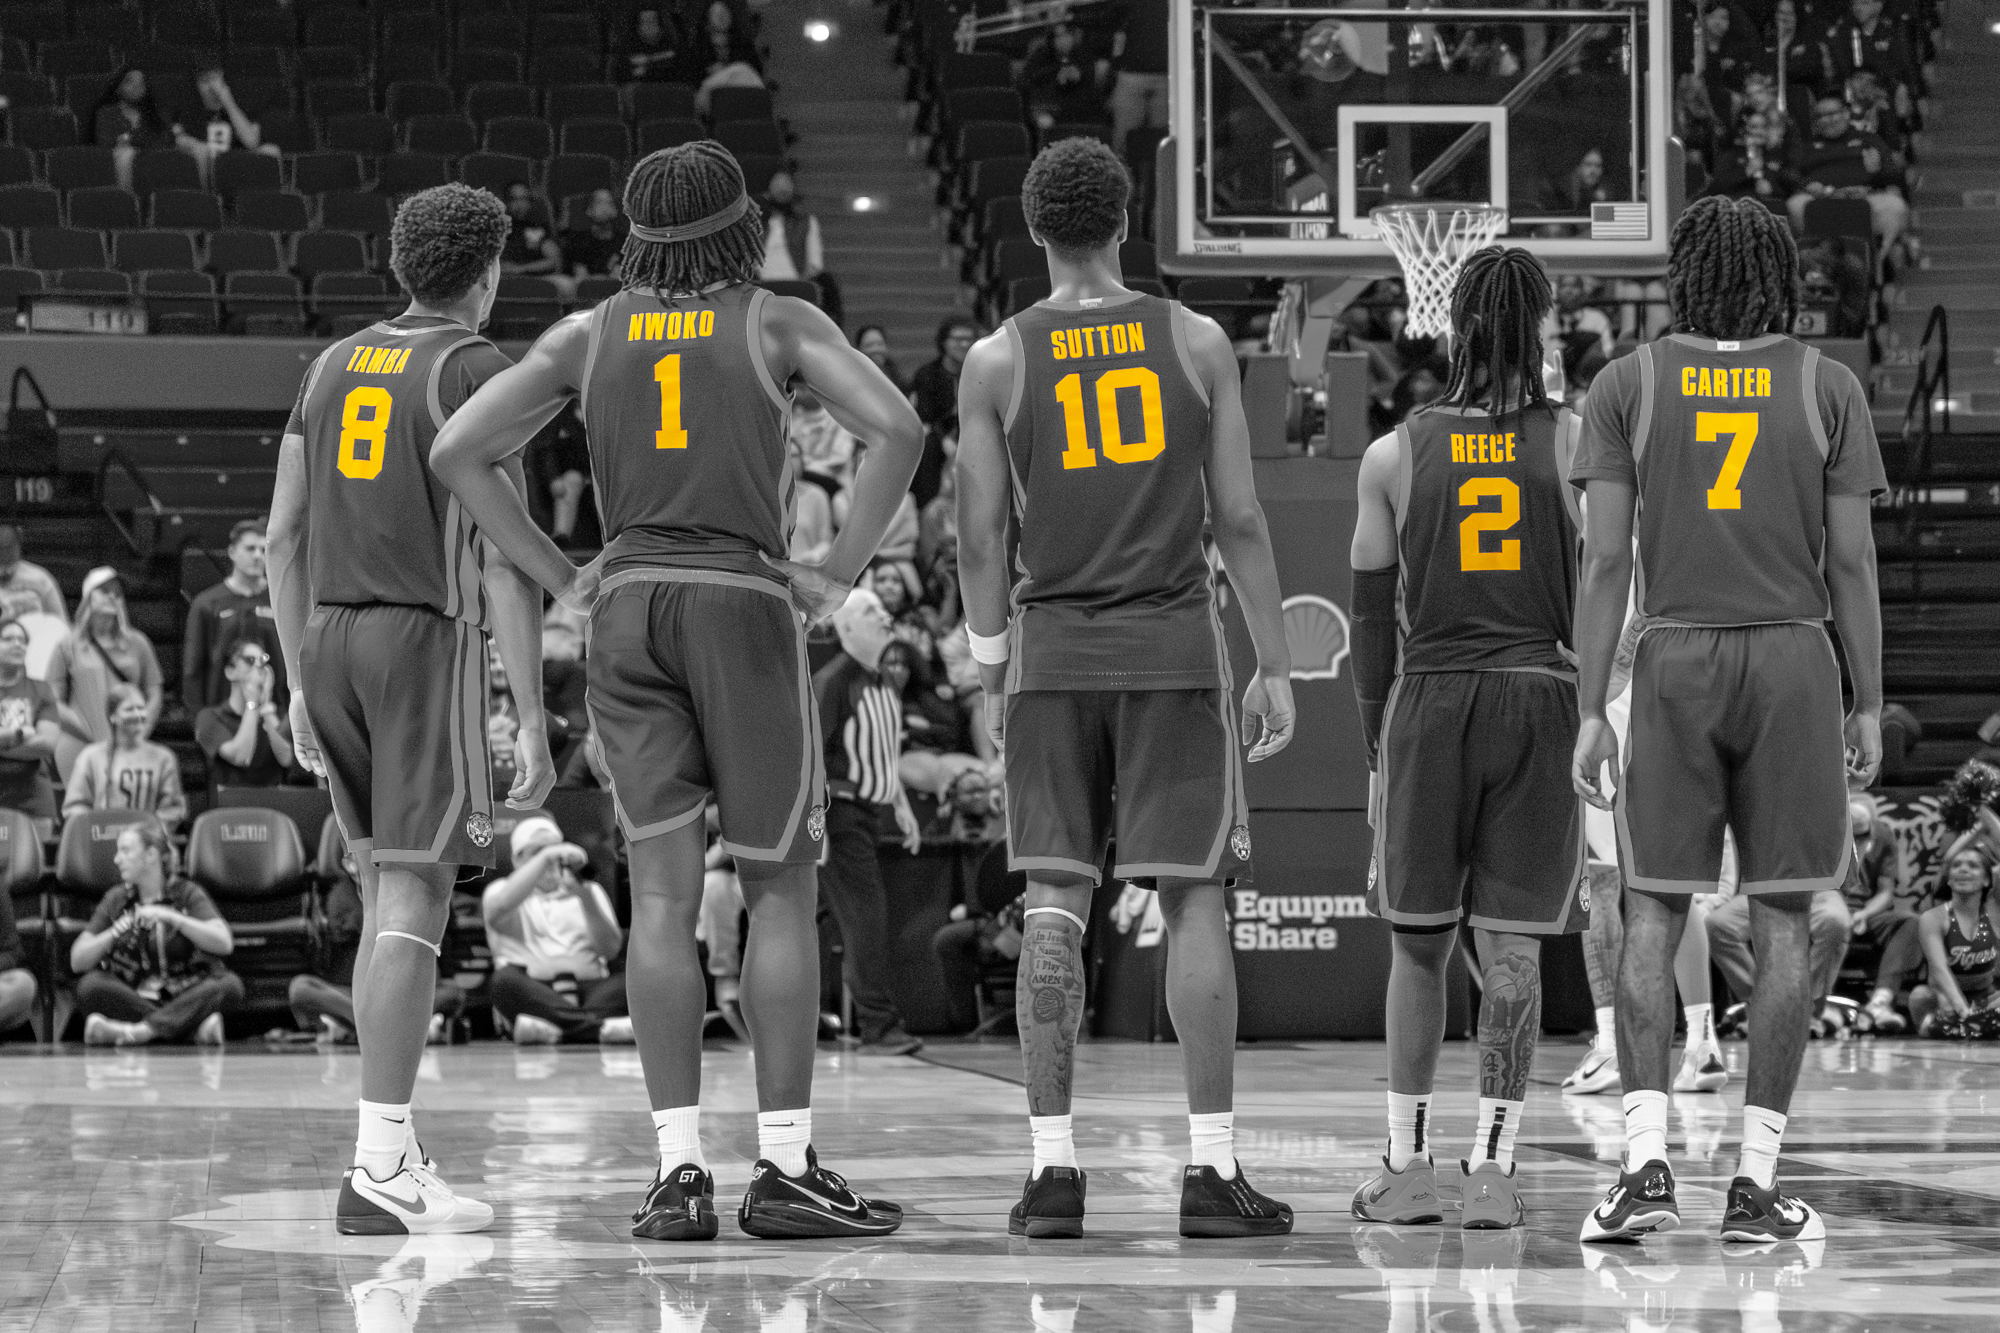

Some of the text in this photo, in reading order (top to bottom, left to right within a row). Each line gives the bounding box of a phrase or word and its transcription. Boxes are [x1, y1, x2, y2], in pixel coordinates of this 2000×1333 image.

[1193, 242, 1242, 255] SPALDING
[629, 311, 714, 341] NWOKO
[1051, 323, 1145, 359] SUTTON
[347, 347, 411, 373] TAMBA
[1682, 367, 1770, 397] CARTER
[655, 354, 687, 449] 1
[338, 387, 392, 479] 8
[1055, 367, 1165, 470] 10
[1451, 433, 1515, 463] REECE
[1696, 412, 1758, 509] 7
[1459, 478, 1521, 571] 2
[1234, 890, 1368, 924] Equipm
[1234, 922, 1338, 950] Share
[1032, 974, 1061, 984] AMEN
[679, 1170, 700, 1183] GT
